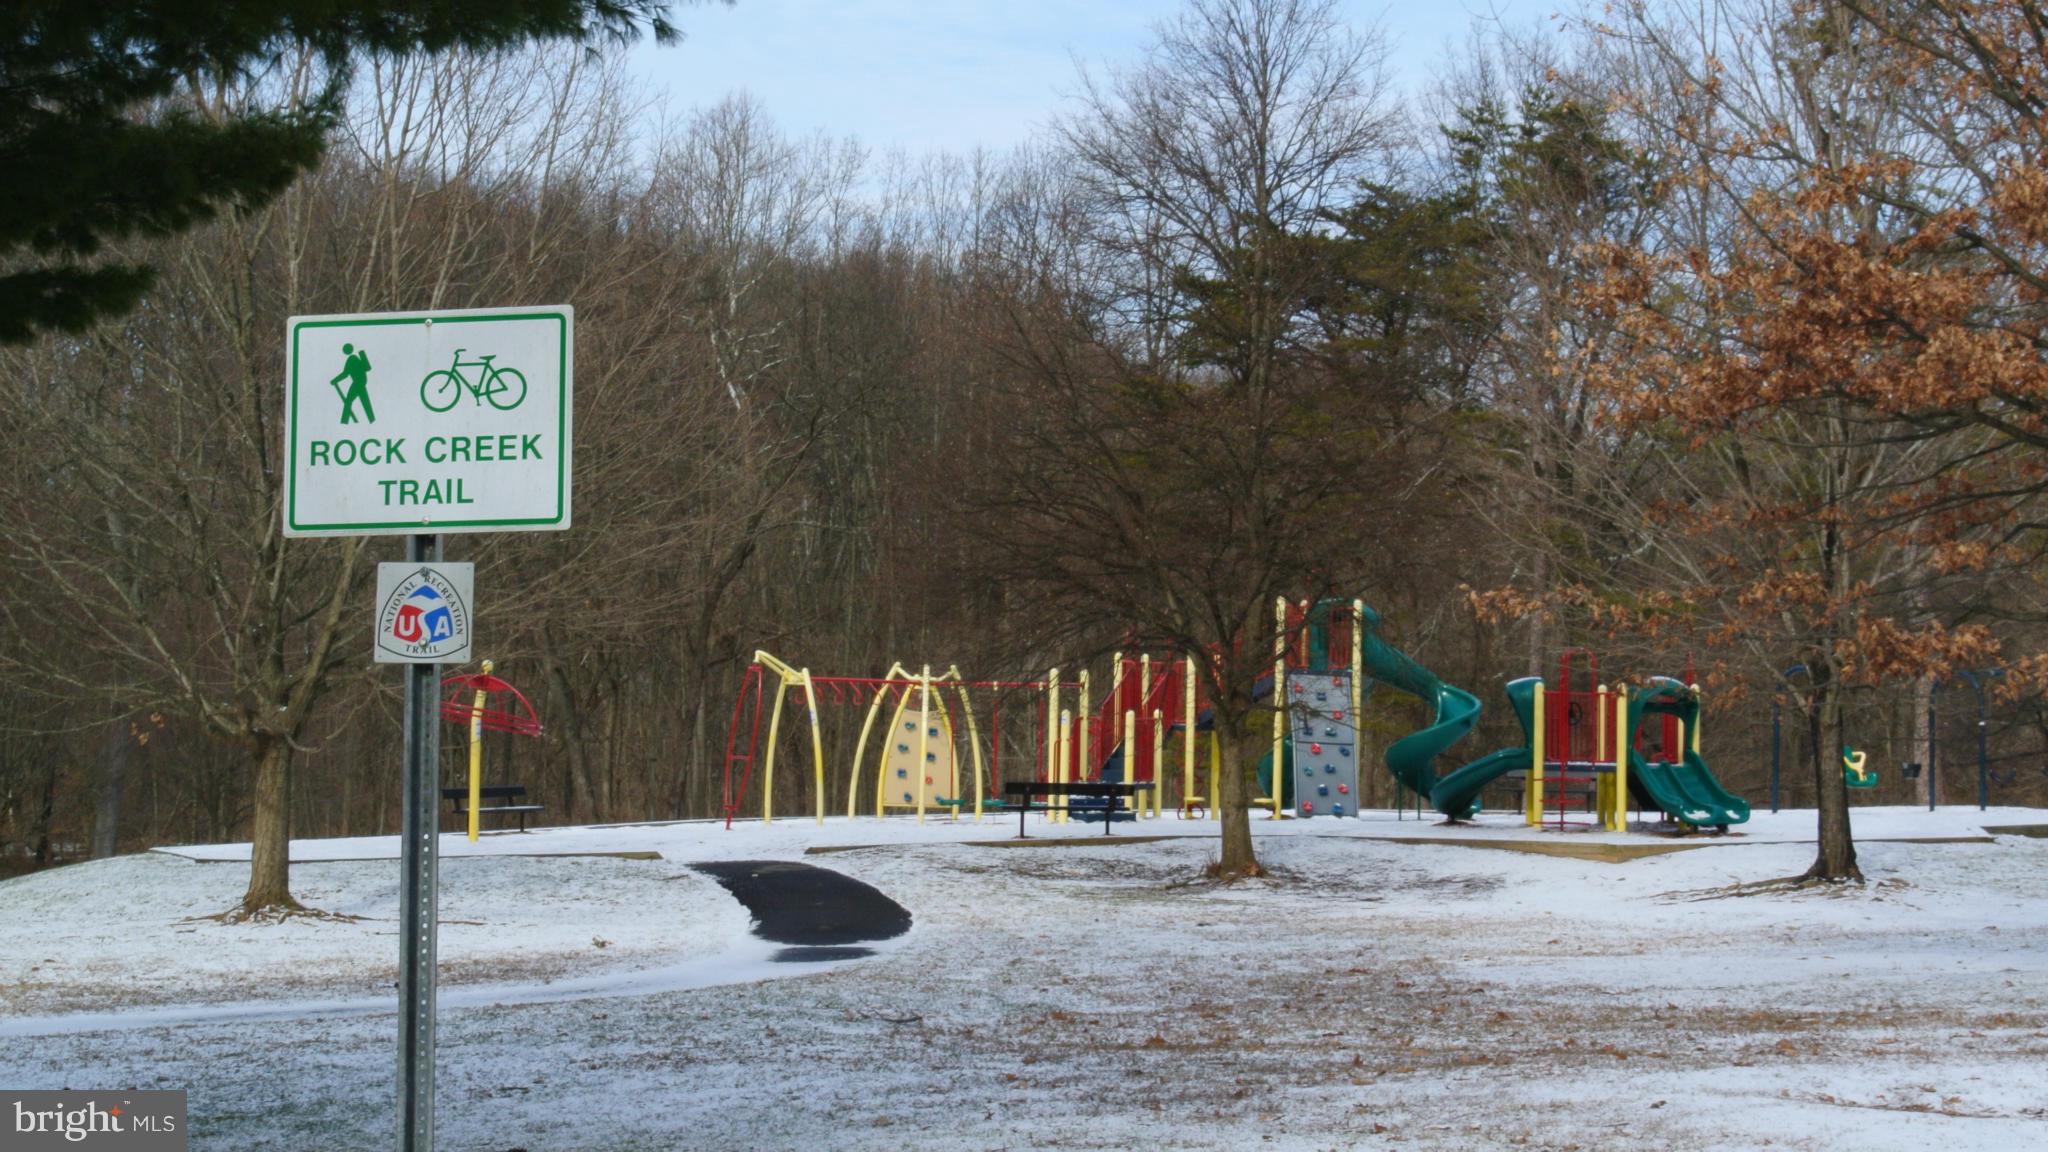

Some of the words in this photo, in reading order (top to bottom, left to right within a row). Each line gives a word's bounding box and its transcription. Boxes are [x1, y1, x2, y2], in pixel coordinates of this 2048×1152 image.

[310, 438, 407, 466] ROCK
[425, 434, 543, 463] CREEK
[378, 478, 474, 506] TRAIL
[384, 581, 417, 633] NATIONAL
[424, 575, 464, 635] RECREATION
[398, 611, 451, 640] USA
[405, 644, 440, 654] TRAIL
